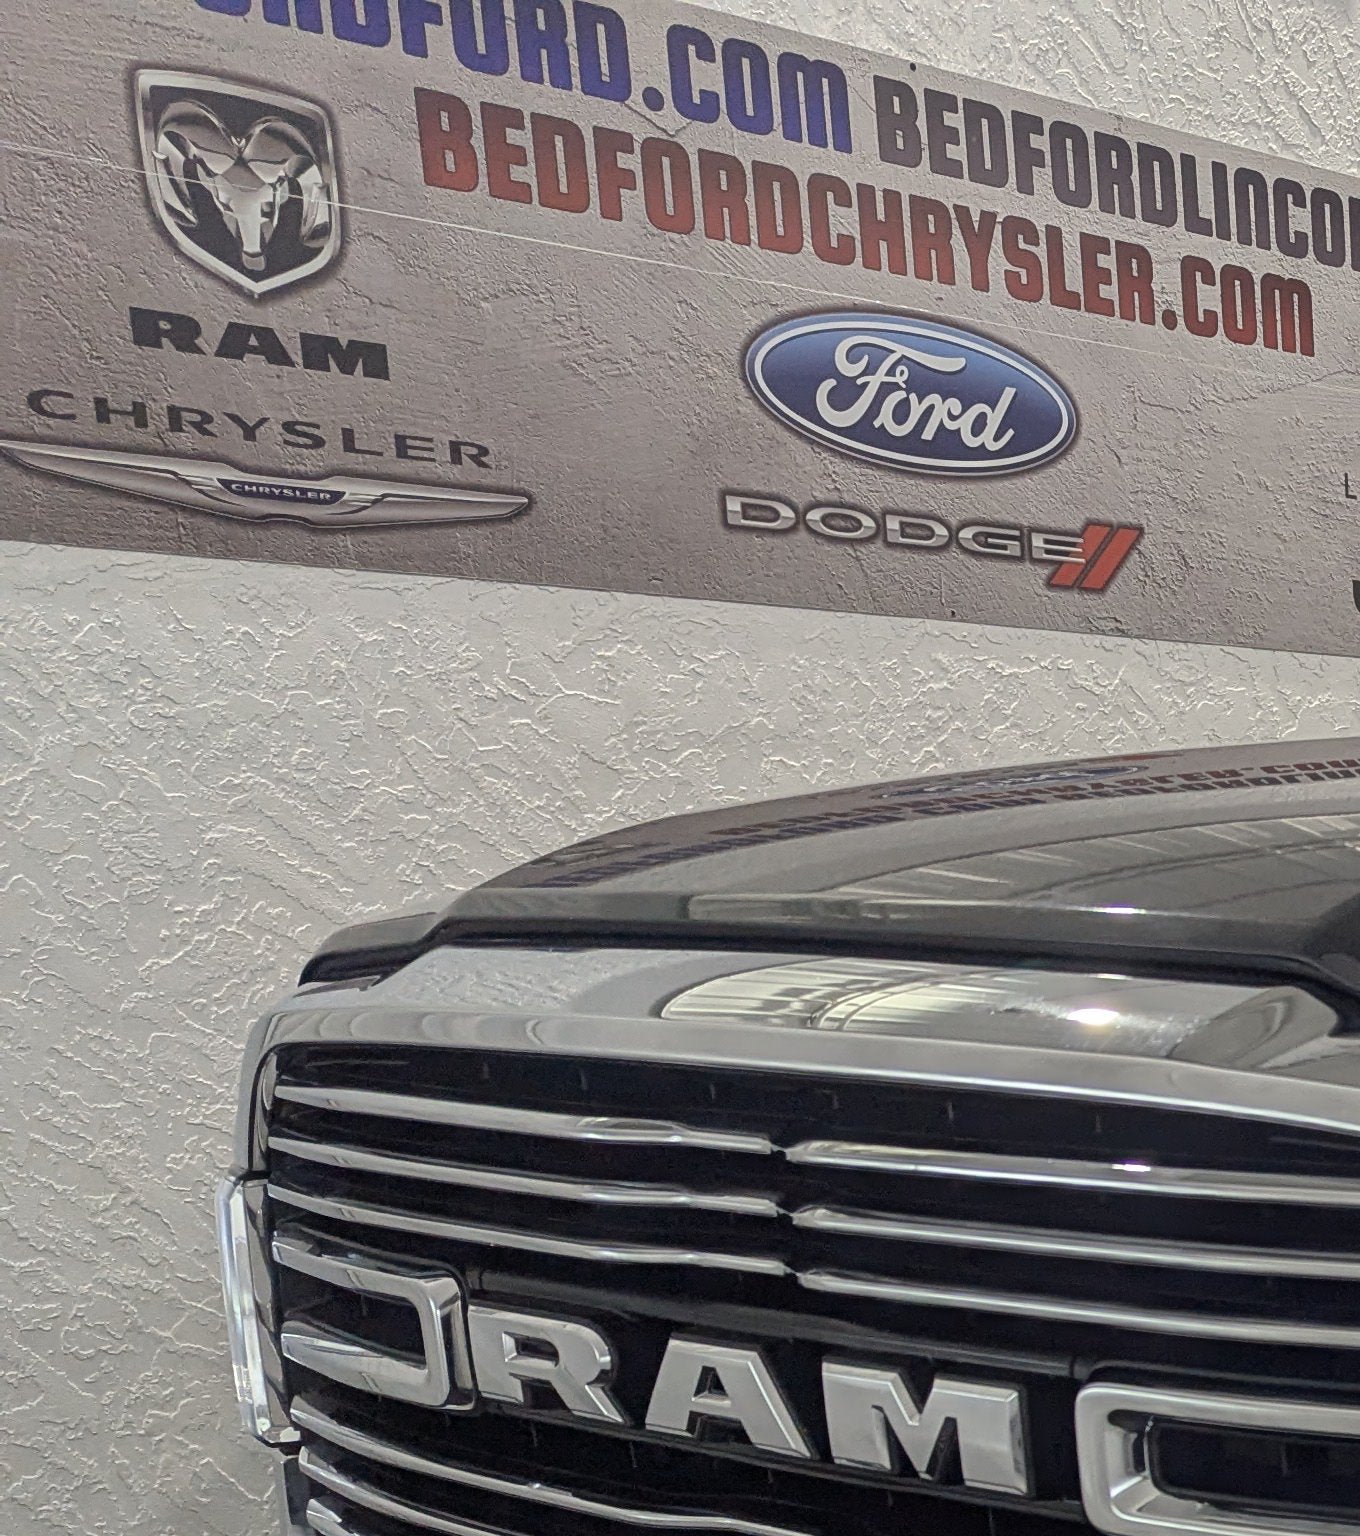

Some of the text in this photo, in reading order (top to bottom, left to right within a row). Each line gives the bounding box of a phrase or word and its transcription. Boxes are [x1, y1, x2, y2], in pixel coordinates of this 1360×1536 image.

[194, 0, 853, 154] FORD.COM
[413, 87, 1315, 357] BEDFORDCHRYSLER.COM
[129, 307, 391, 381] RAM
[27, 389, 492, 469] CHRYSLER
[815, 335, 1015, 453] Ford
[230, 483, 332, 502] CHRYSLER
[725, 495, 1087, 565] DODGE
[469, 1304, 1028, 1494] RAM
